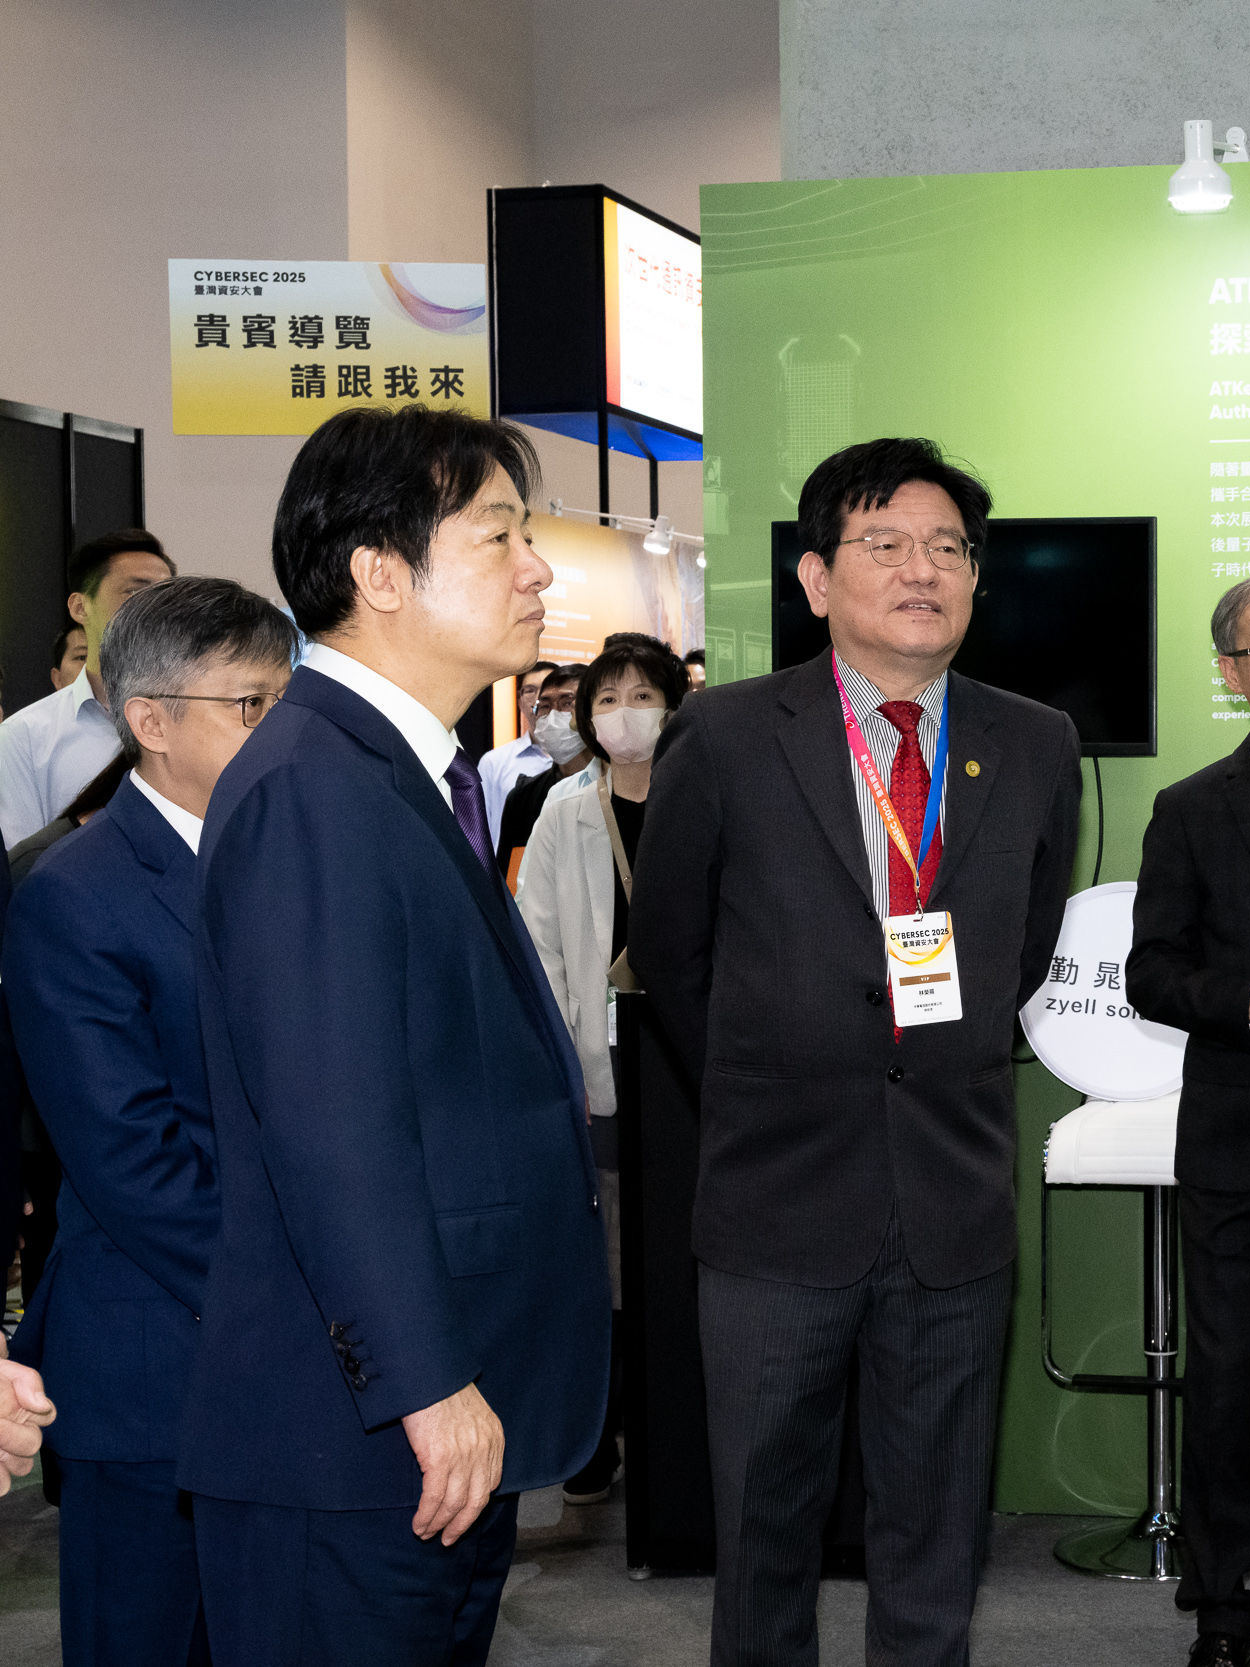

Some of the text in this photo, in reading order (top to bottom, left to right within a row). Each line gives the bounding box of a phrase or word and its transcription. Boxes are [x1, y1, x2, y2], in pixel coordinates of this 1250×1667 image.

[194, 271, 306, 282] CYBERSEC 2025
[194, 285, 263, 296] 臺灣資安大會
[194, 314, 372, 350] 貴賓導覽
[290, 364, 464, 400] 請跟我來
[880, 798, 895, 821] 2025
[890, 928, 949, 941] CYBERSEC 2025
[1046, 998, 1096, 1015] zyell
